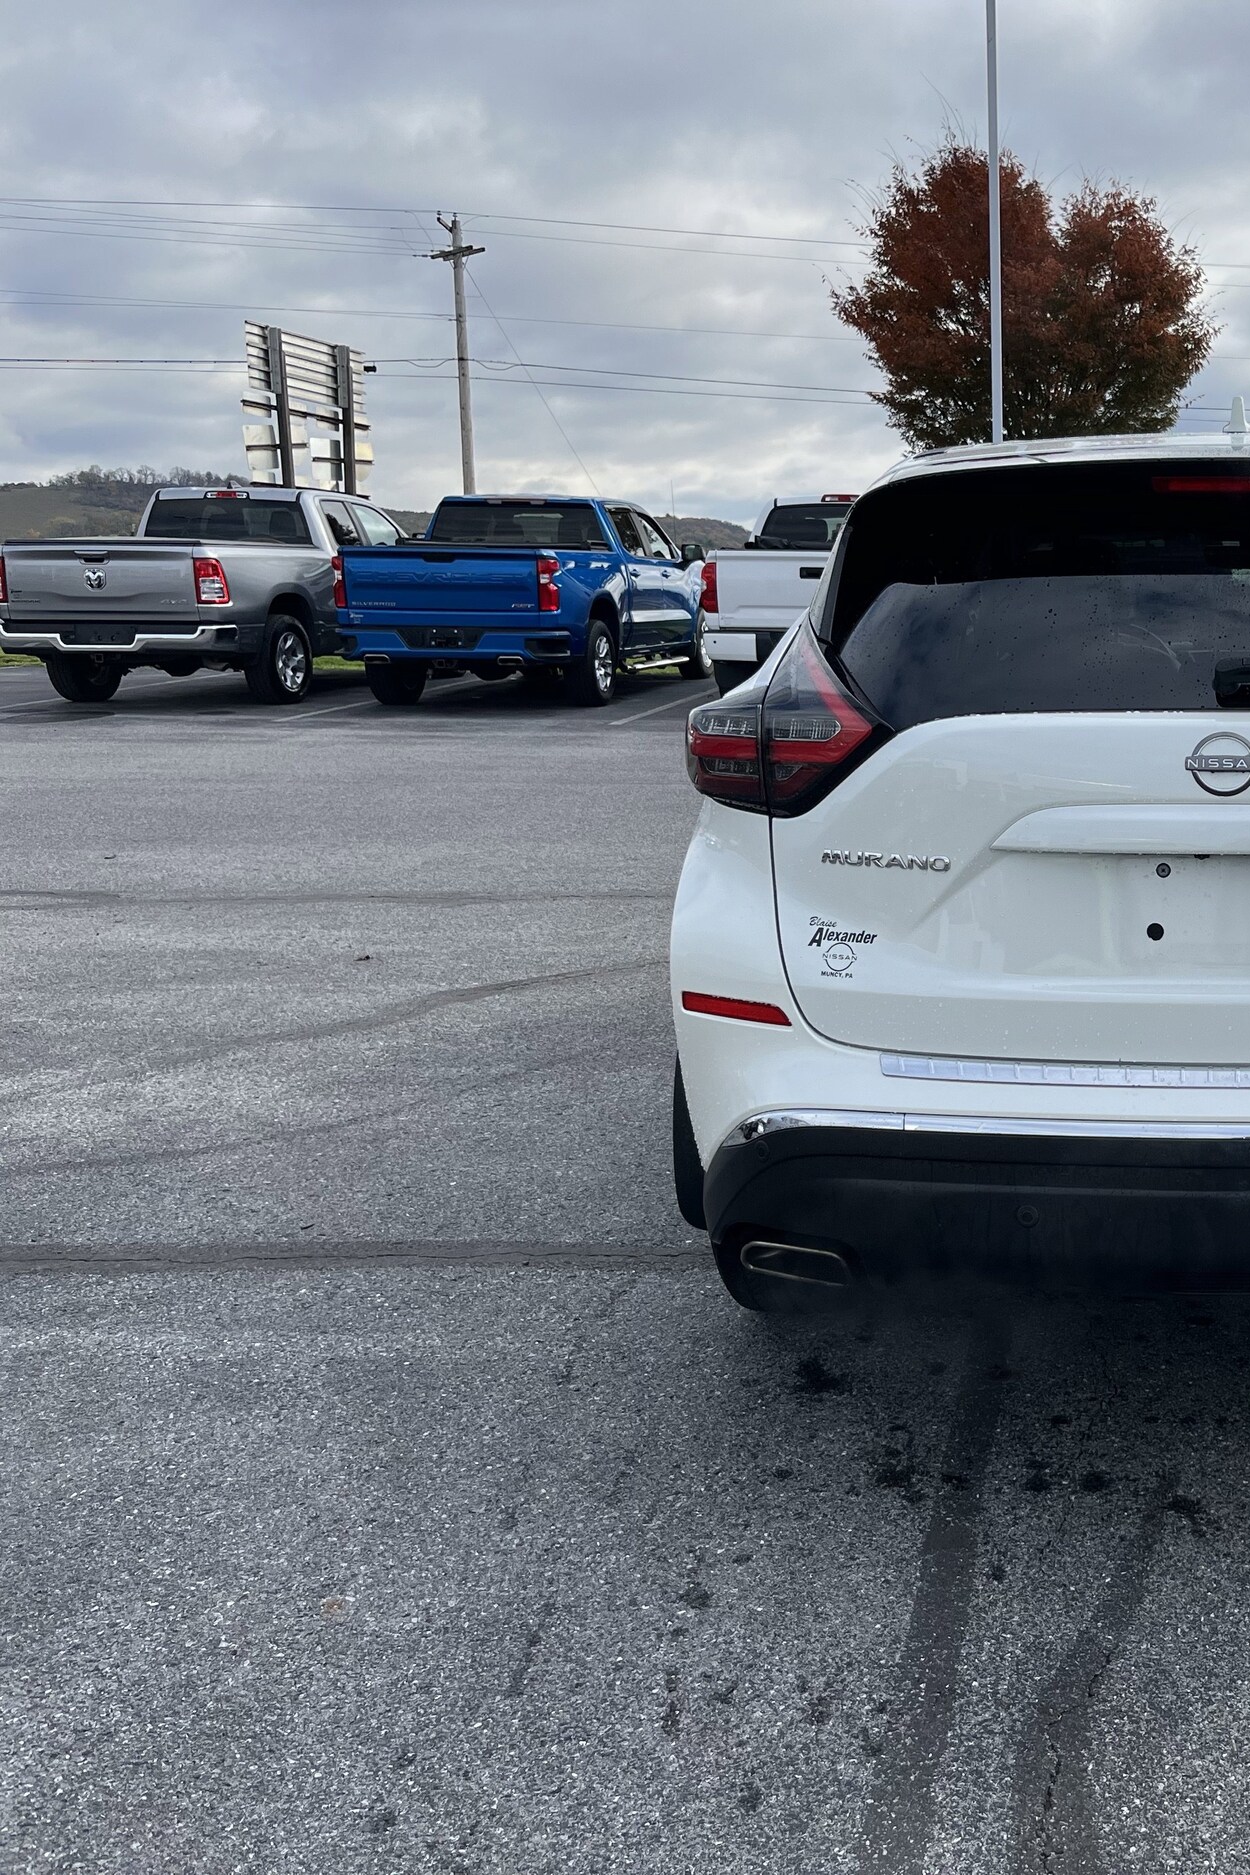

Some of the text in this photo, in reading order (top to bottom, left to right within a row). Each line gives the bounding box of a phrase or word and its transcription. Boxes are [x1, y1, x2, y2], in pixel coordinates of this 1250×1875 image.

[820, 848, 952, 873] MURANO
[809, 915, 838, 928] Blaise
[807, 927, 878, 947] Alexander
[822, 953, 858, 962] NISSAN
[820, 970, 844, 979] MUNCY,
